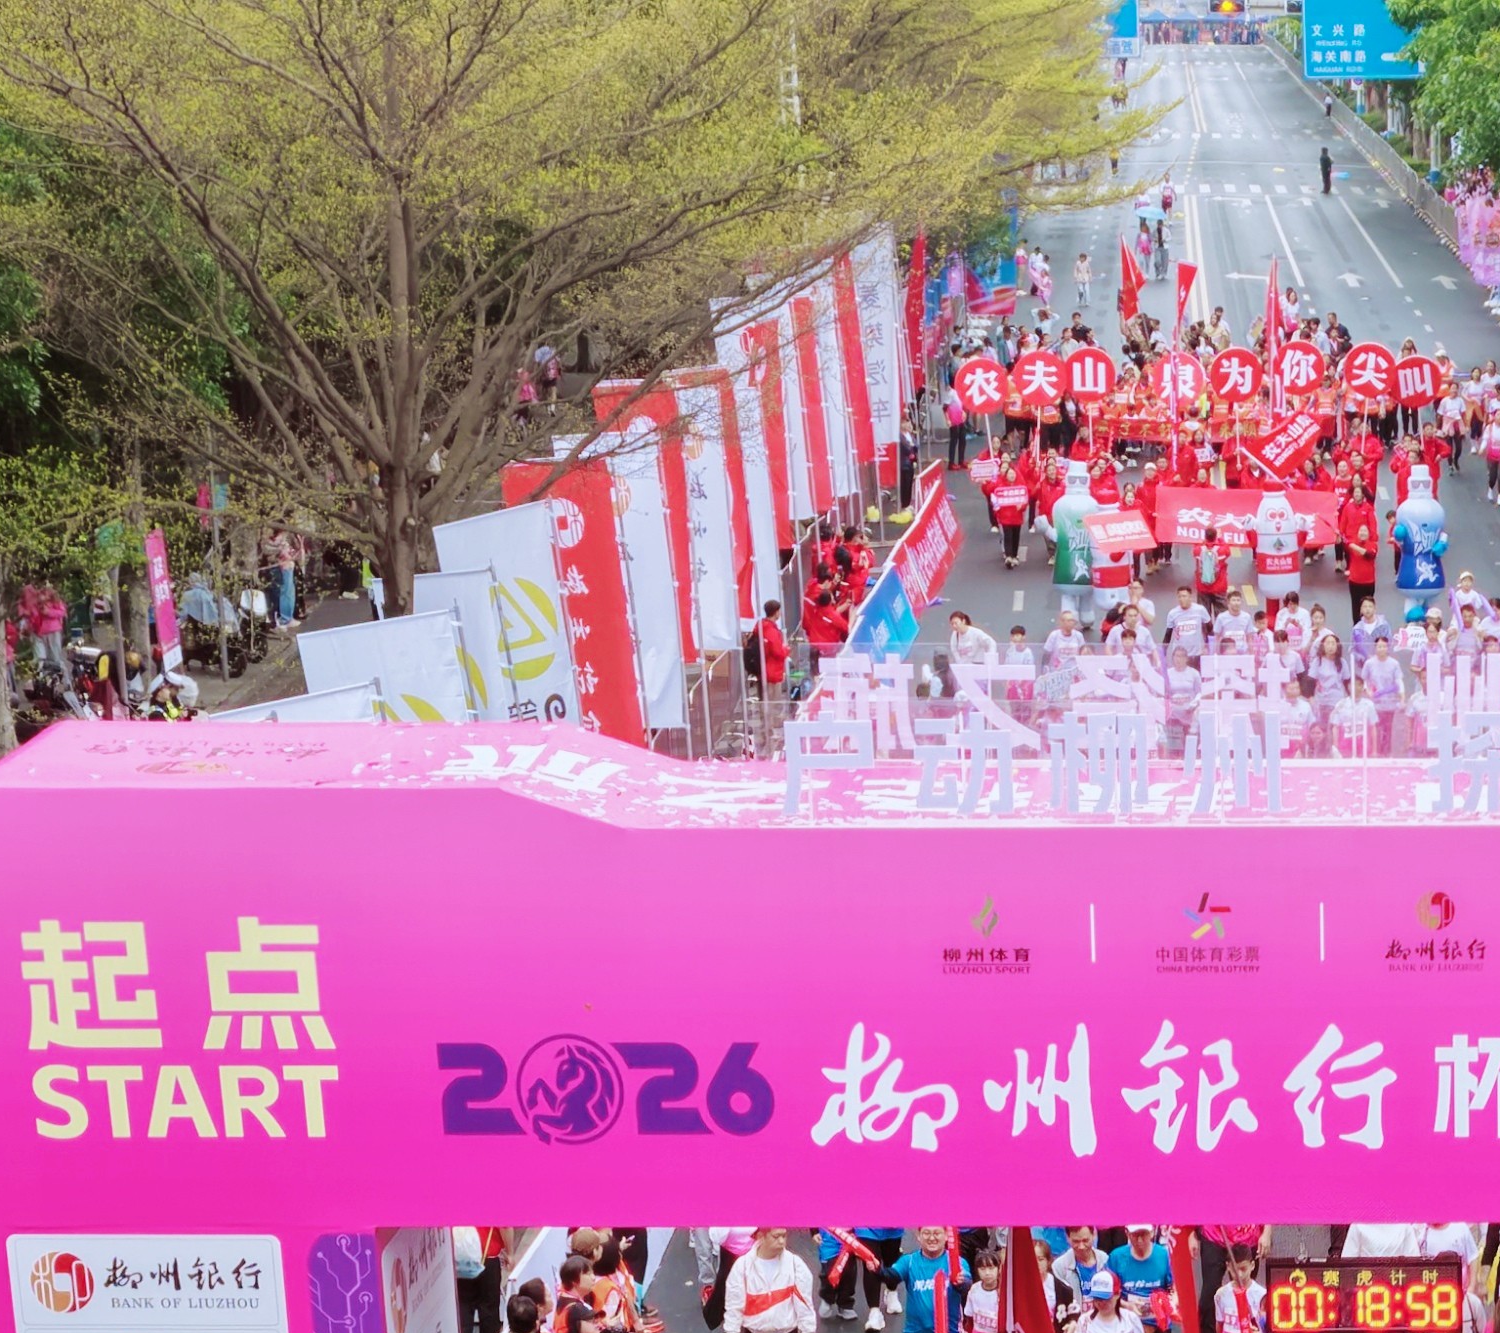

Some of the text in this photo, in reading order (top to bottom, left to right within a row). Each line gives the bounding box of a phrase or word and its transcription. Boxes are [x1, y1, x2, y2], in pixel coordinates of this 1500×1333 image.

[1311, 24, 1366, 36] 文兴路
[943, 948, 1030, 962] 柳州体育
[1156, 946, 1260, 963] 中国体育彩票
[21, 915, 338, 1052] 起点
[35, 1063, 338, 1140] START
[104, 1257, 262, 1290] 柳州银行
[111, 1298, 260, 1309] BANK OF LIUZHOU
[1272, 1285, 1458, 1329] 00:18:58
